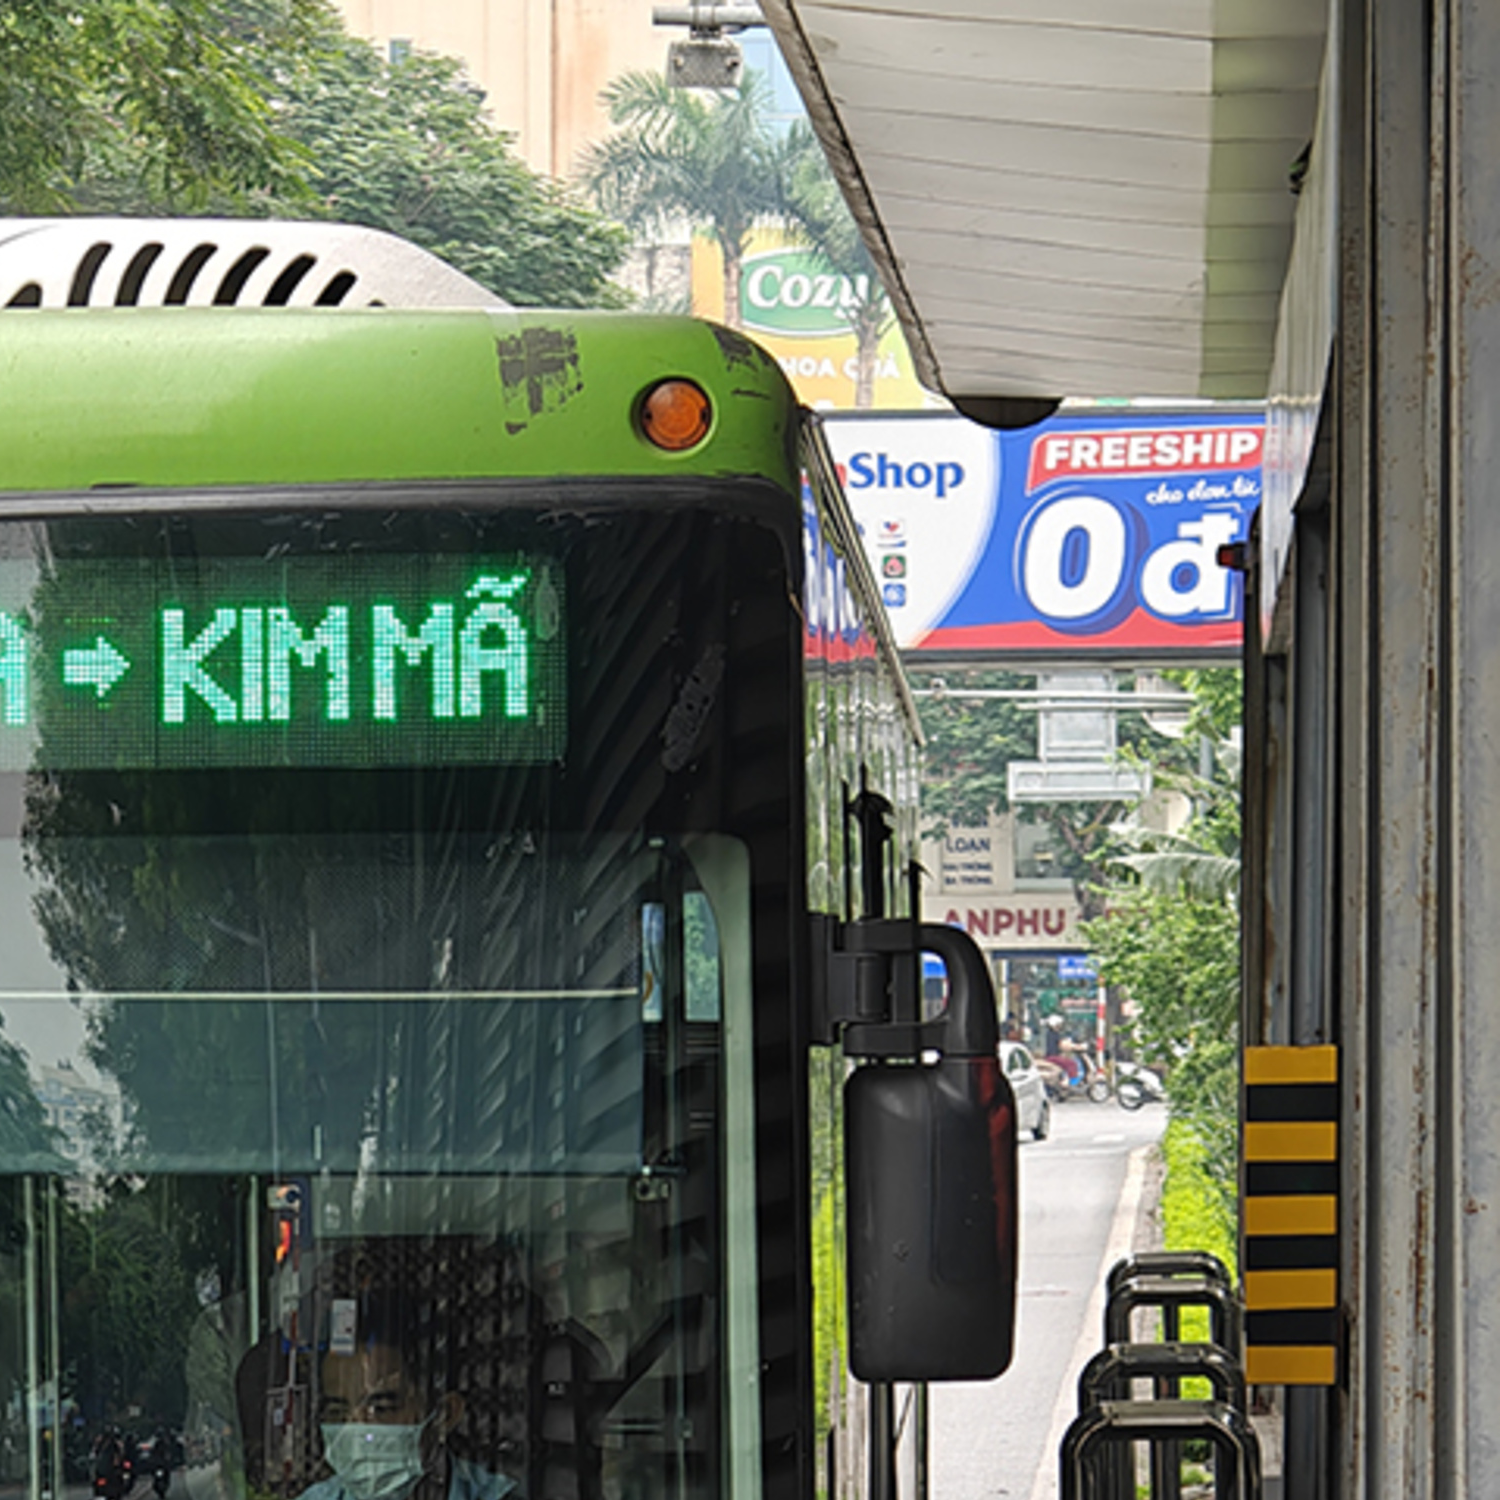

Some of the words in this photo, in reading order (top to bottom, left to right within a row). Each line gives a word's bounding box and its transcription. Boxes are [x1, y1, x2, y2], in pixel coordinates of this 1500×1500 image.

[1044, 431, 1260, 470] FREESHIP
[161, 606, 351, 724] KIM
[372, 574, 530, 720] MÃ
